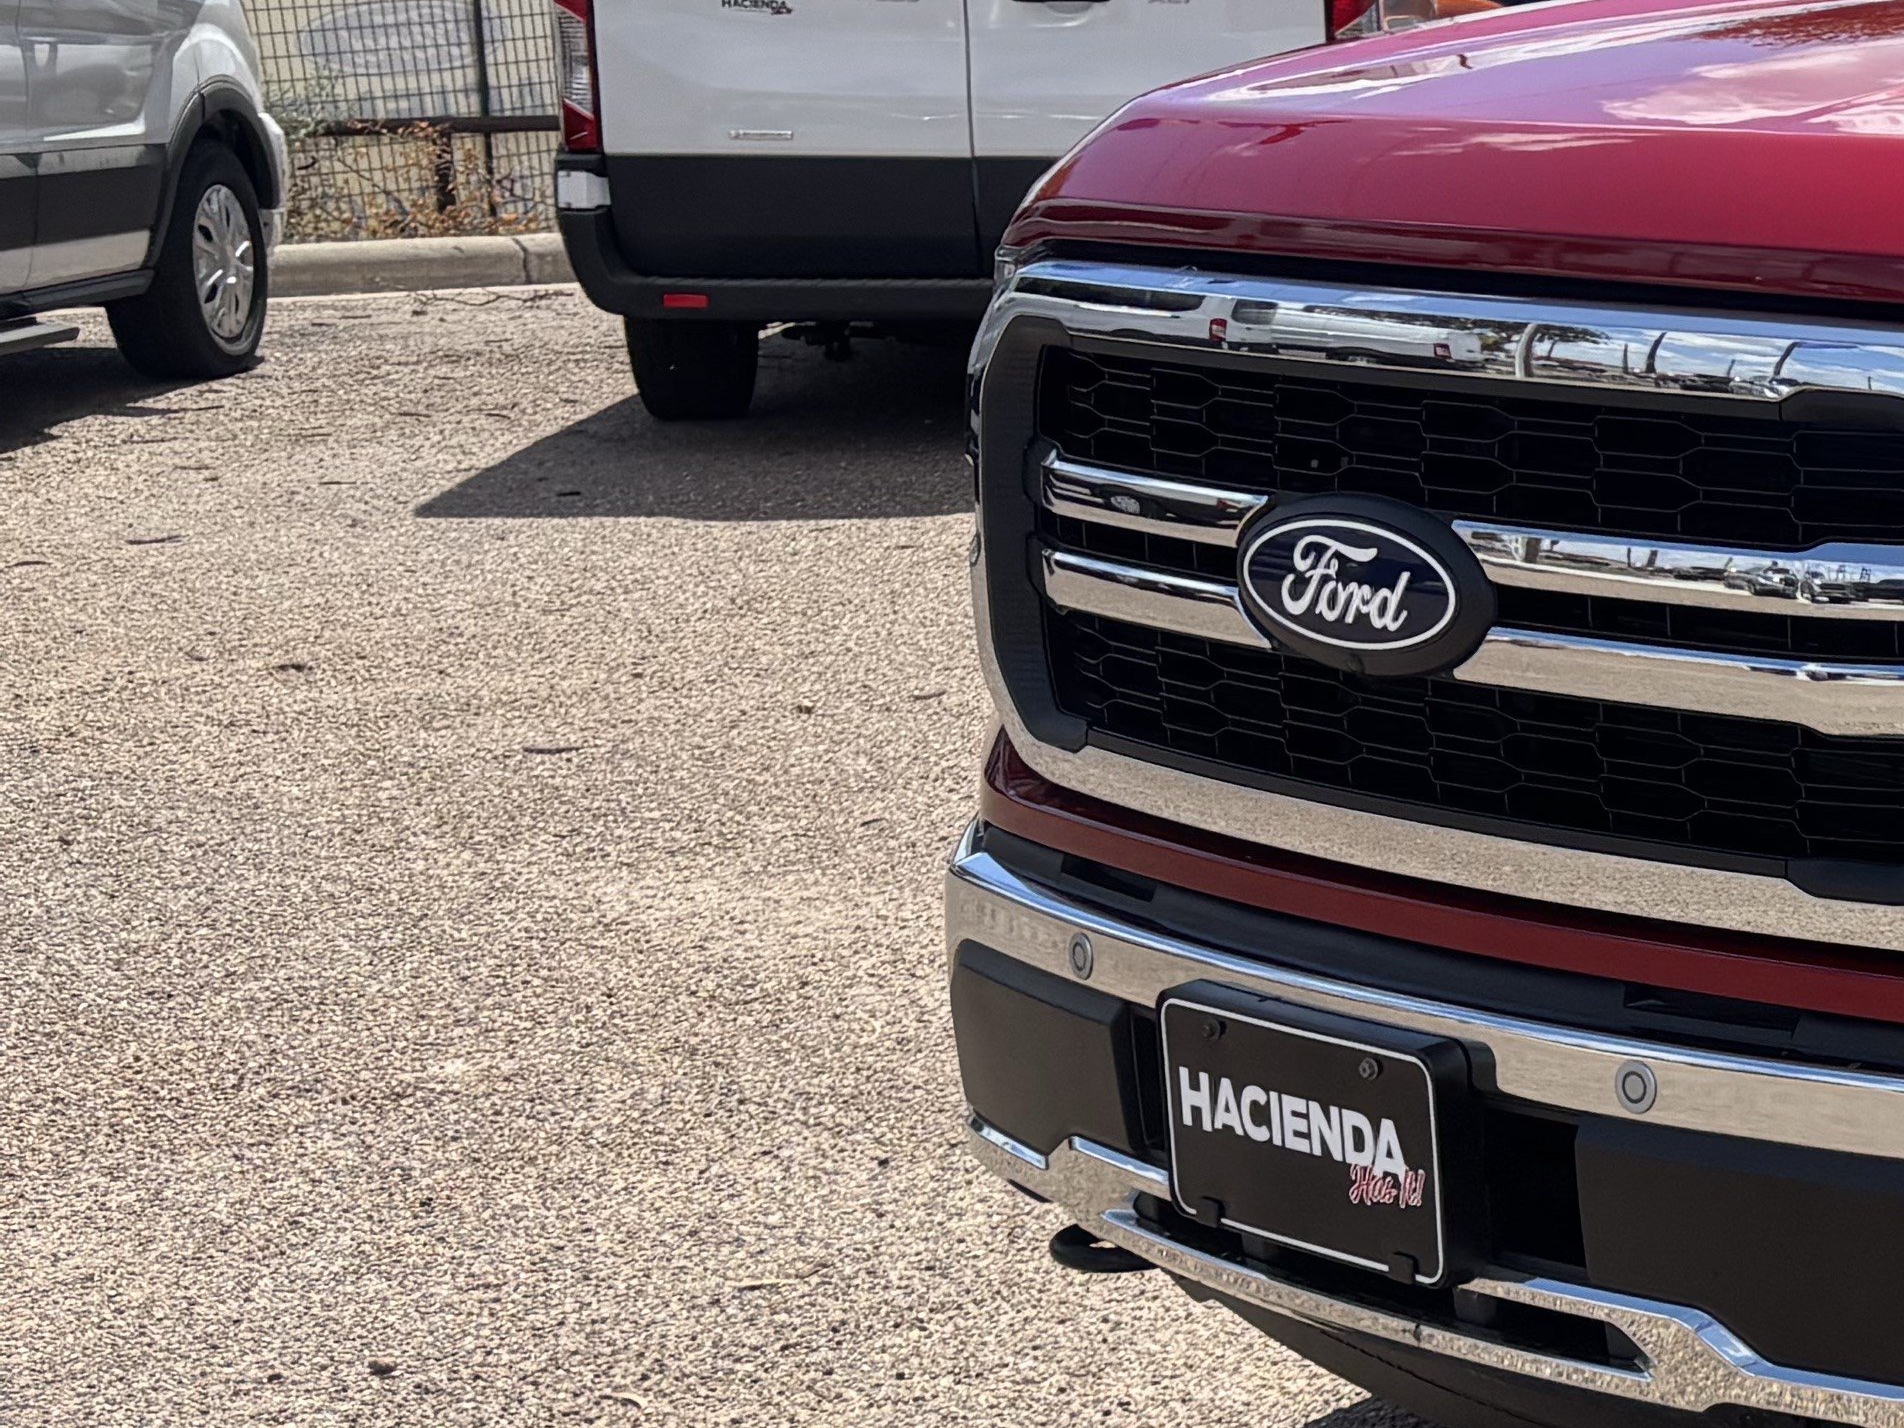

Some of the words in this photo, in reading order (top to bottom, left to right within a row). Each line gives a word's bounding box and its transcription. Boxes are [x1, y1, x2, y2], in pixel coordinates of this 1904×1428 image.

[1281, 534, 1411, 632] Ford
[1178, 1065, 1406, 1182] HACIENDA
[1348, 1163, 1398, 1207] Has
